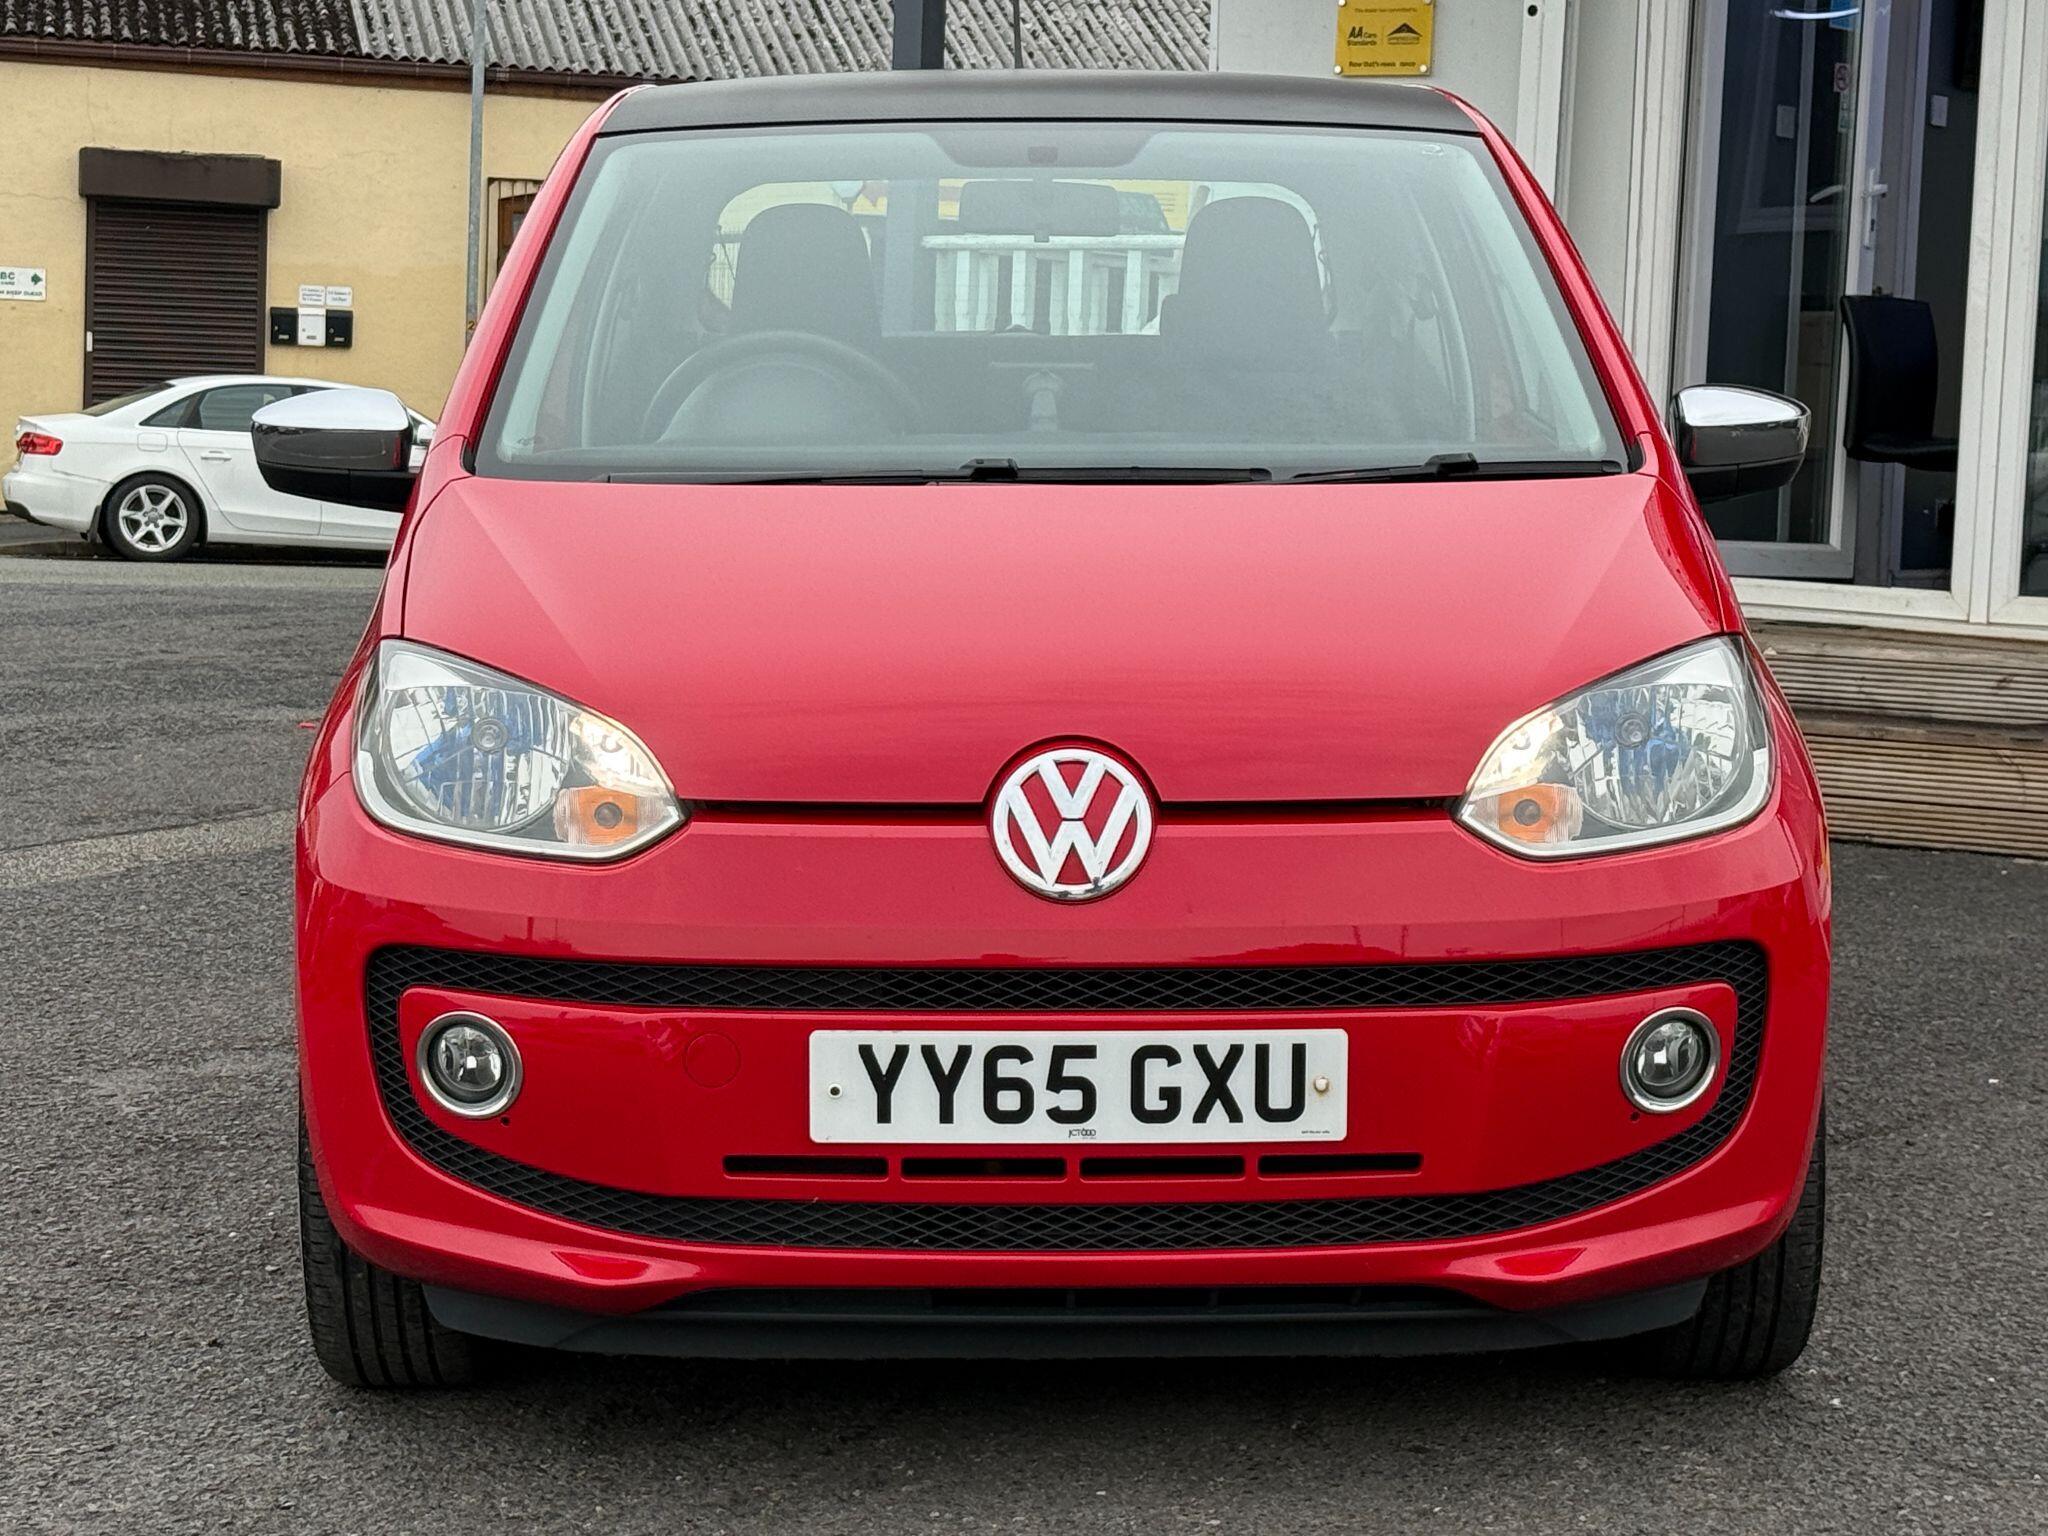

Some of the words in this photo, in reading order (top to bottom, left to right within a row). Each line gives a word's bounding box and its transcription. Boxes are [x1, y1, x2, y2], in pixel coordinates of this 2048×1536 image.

[1348, 26, 1364, 39] AA
[858, 1044, 1097, 1125] YY65
[1130, 1043, 1307, 1124] GXU
